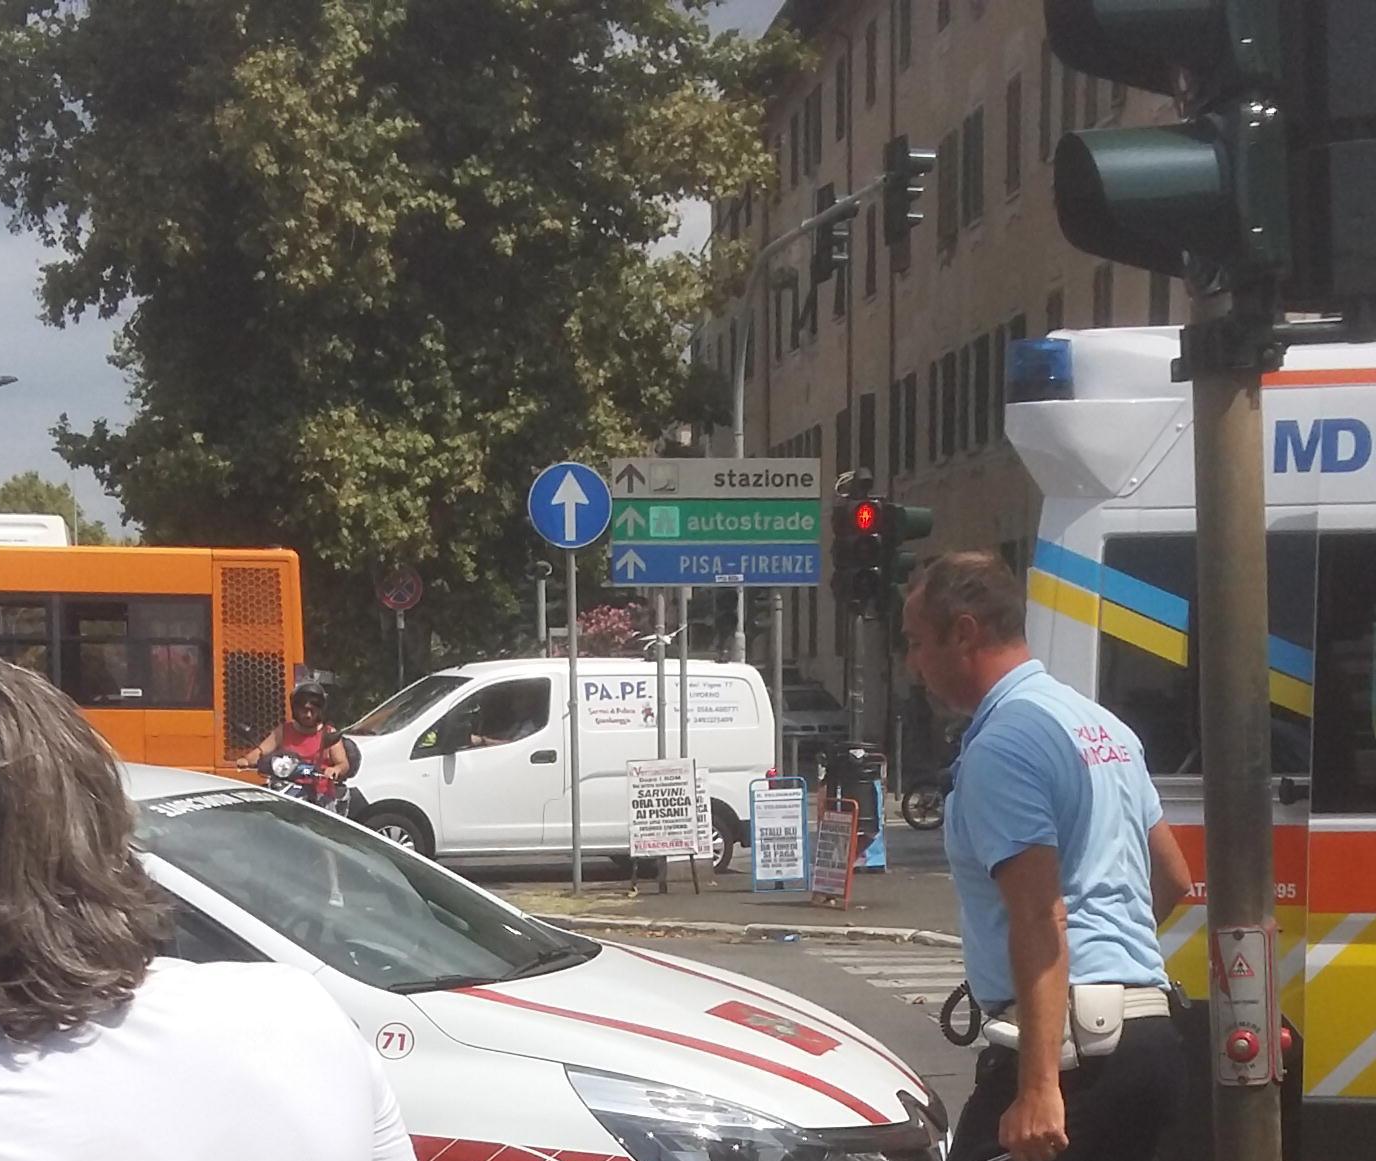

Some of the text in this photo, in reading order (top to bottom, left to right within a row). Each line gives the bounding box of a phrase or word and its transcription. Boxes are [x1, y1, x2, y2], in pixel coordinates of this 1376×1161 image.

[713, 469, 814, 488] stazione
[687, 512, 815, 531] autostrade
[583, 680, 653, 701] PA.PE.
[631, 796, 692, 809] ORA TOCCA
[637, 787, 686, 799] SARVINI:
[636, 807, 689, 819] AI PISANI!
[382, 1032, 406, 1051] 71
